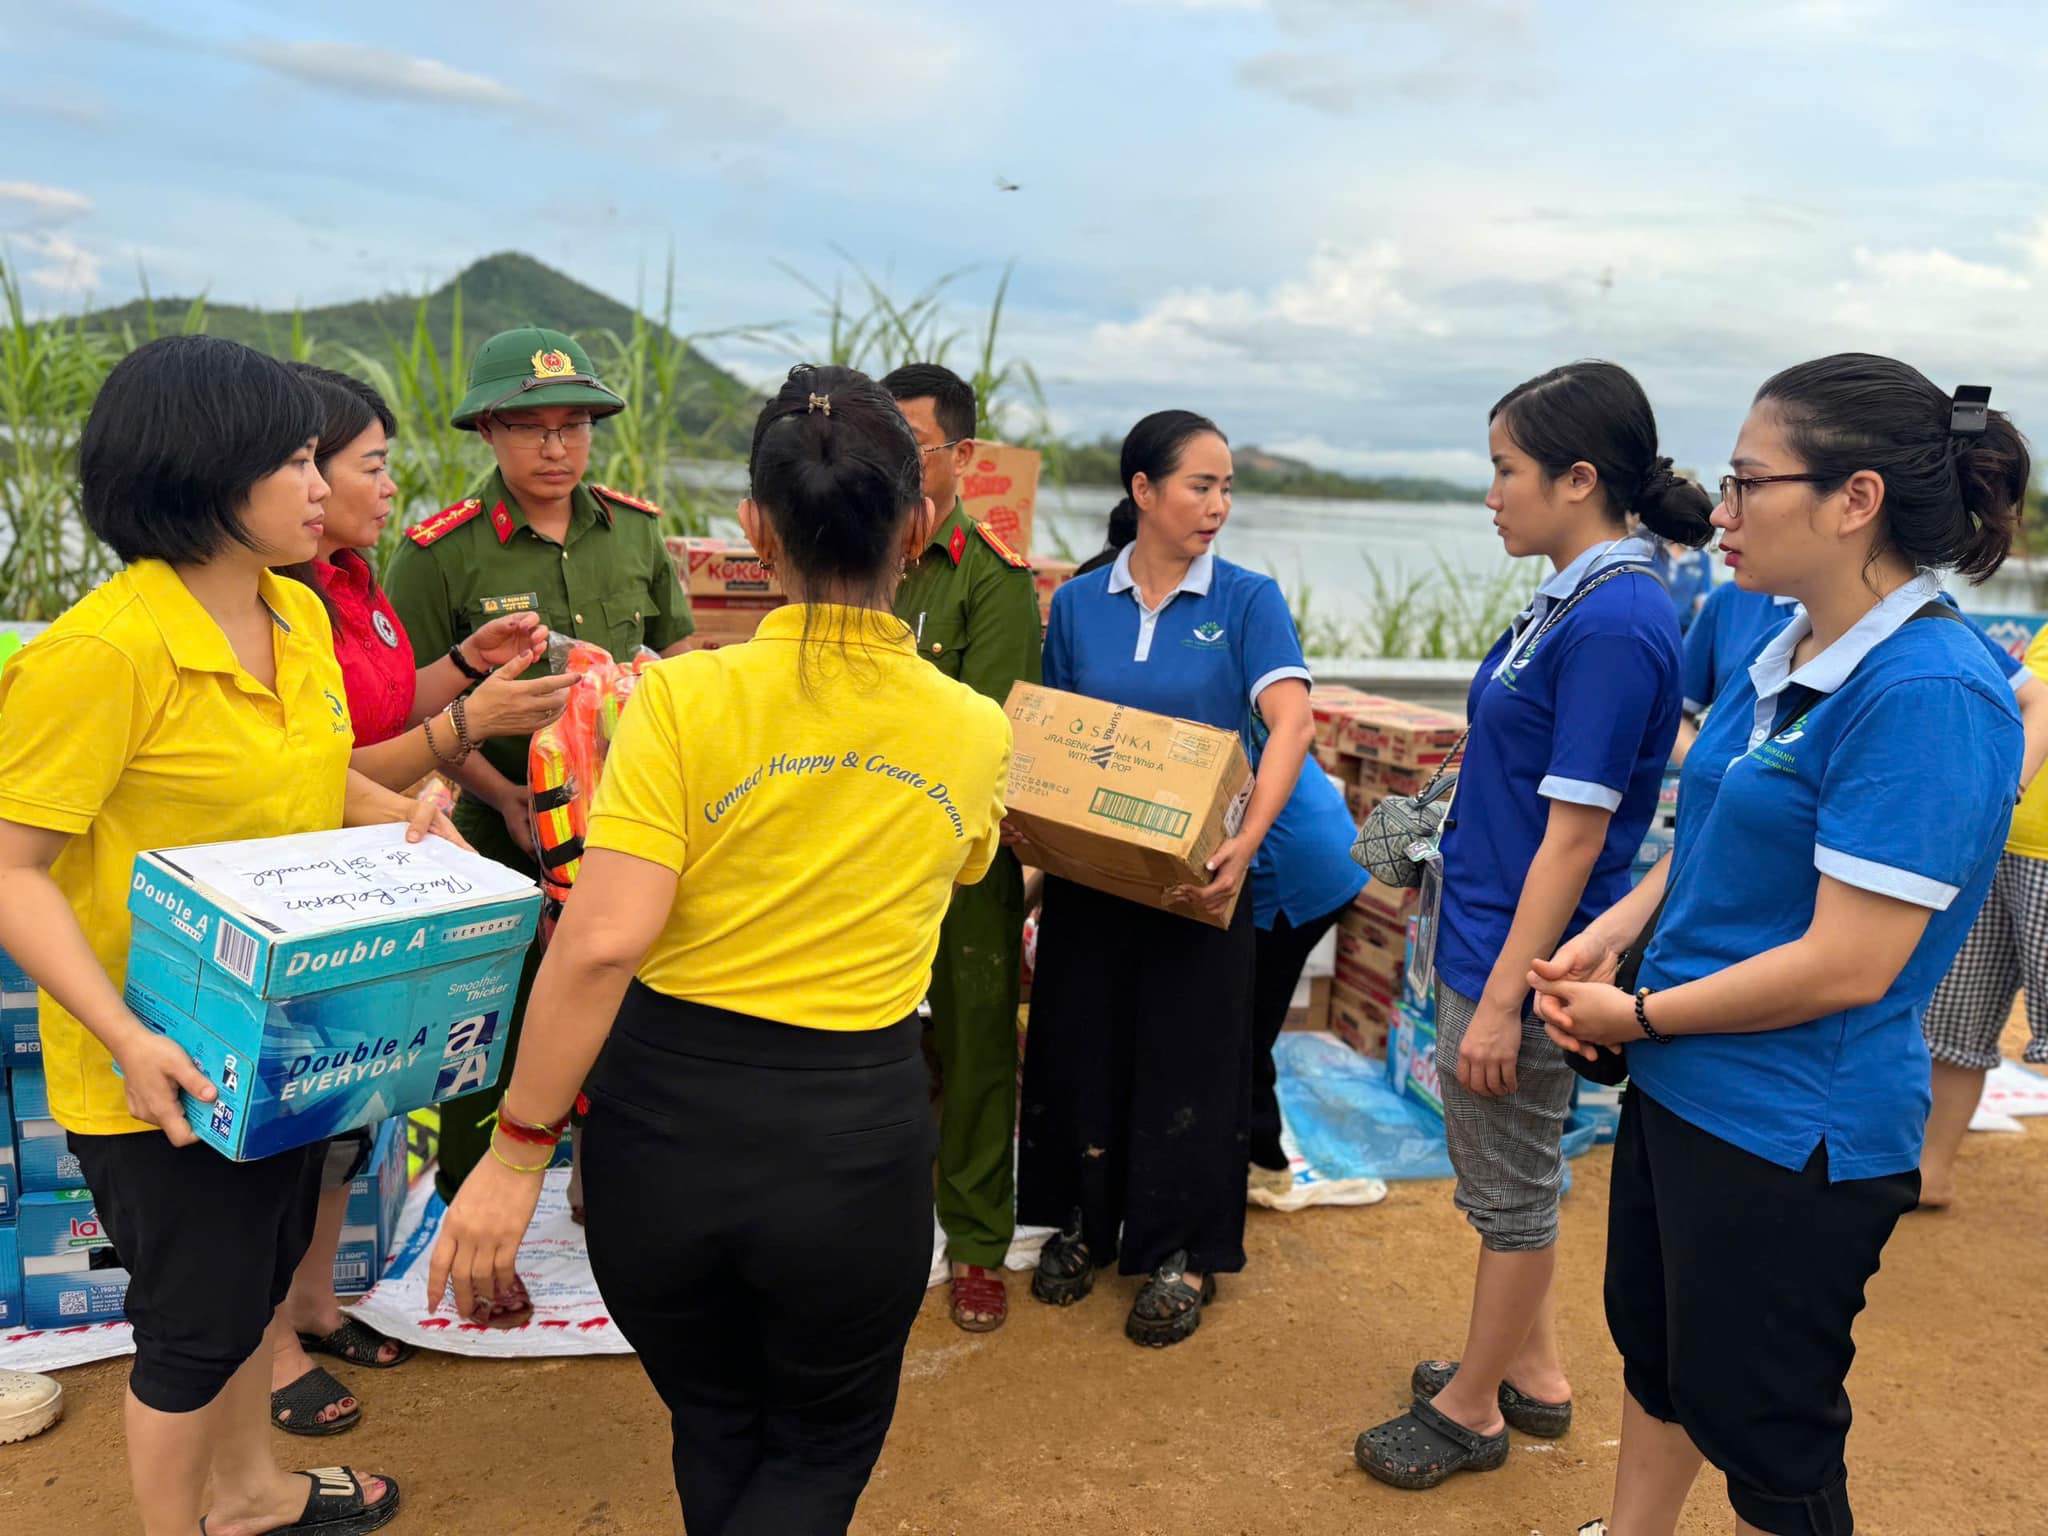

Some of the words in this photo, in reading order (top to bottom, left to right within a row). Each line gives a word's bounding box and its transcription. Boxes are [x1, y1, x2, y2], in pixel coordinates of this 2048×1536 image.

[1090, 726, 1152, 752] SNKA
[1111, 761, 1132, 772] POP
[704, 764, 764, 824] Connect
[768, 753, 837, 776] Happy
[840, 751, 860, 768] &
[865, 754, 928, 789] Create
[927, 782, 964, 839] Dream
[132, 871, 193, 921] Double
[195, 914, 210, 935] A
[442, 919, 513, 940] EVERYDAY
[286, 936, 396, 977] Double
[407, 928, 427, 952] A
[448, 975, 503, 997] Smoother
[466, 983, 510, 1002] Thicker
[288, 1036, 399, 1079] Double
[408, 1025, 428, 1049] A
[280, 1050, 422, 1101] EVERYDAY
[71, 1216, 99, 1238] la
